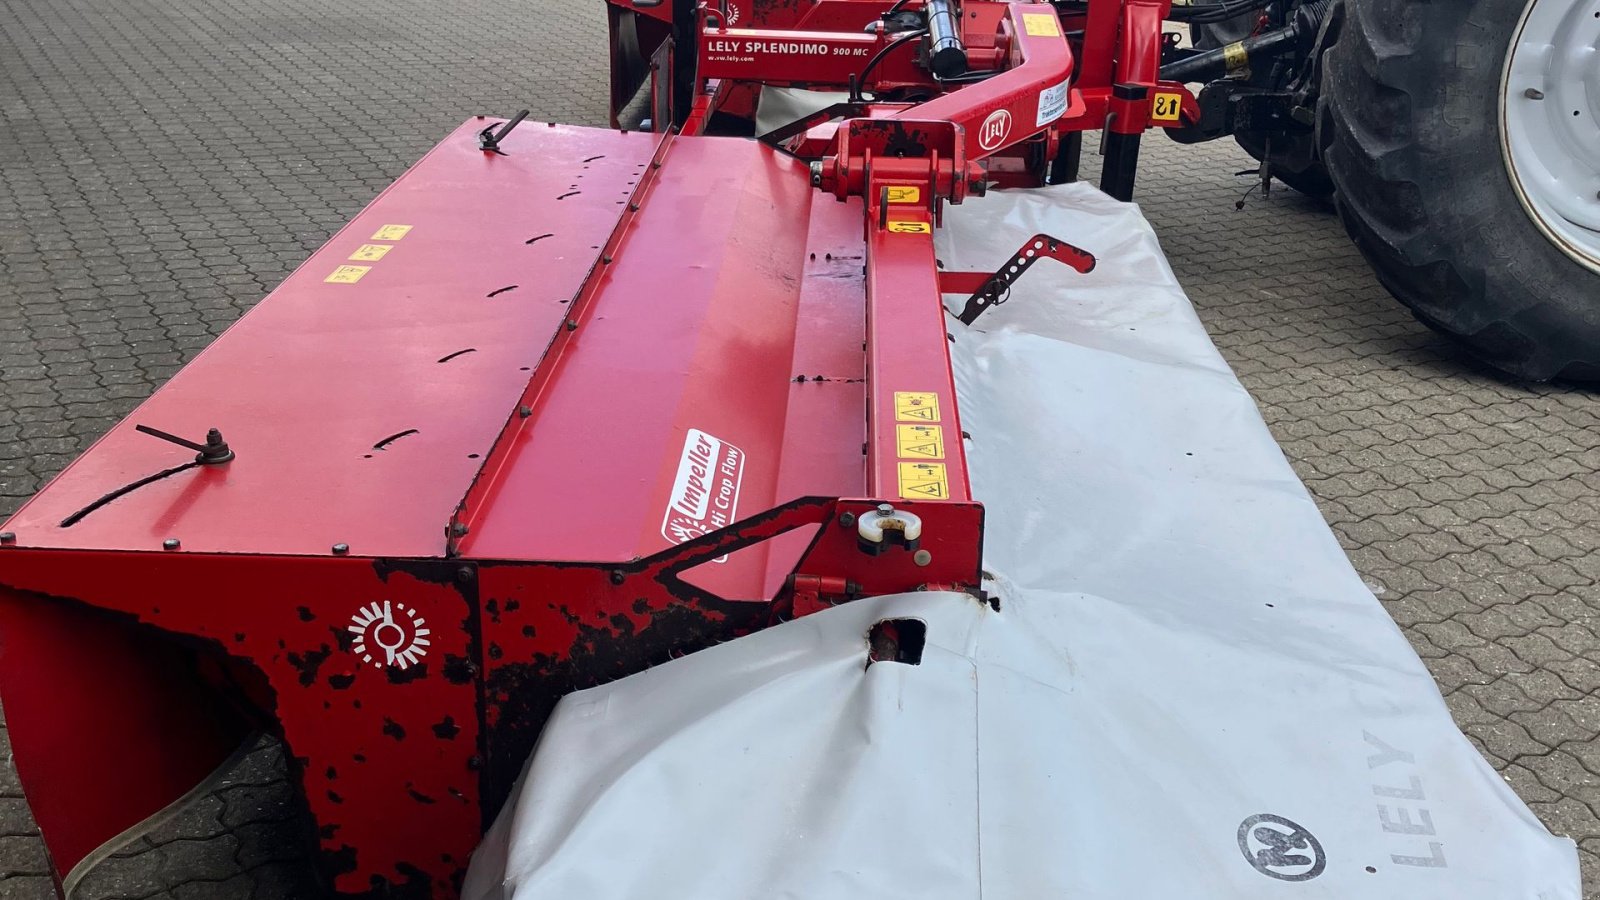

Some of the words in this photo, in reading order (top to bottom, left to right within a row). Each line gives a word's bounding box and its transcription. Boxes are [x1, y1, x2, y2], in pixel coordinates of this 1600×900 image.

[708, 41, 740, 53] LELY
[745, 42, 829, 56] SPLENDIMO
[833, 48, 851, 56] 900
[853, 48, 869, 56] MC
[985, 113, 1006, 145] LELY
[677, 434, 712, 516] Impeller
[721, 447, 739, 477] Flow
[715, 478, 736, 510] Crop
[711, 511, 727, 528] Hi
[1362, 729, 1448, 869] LELY
